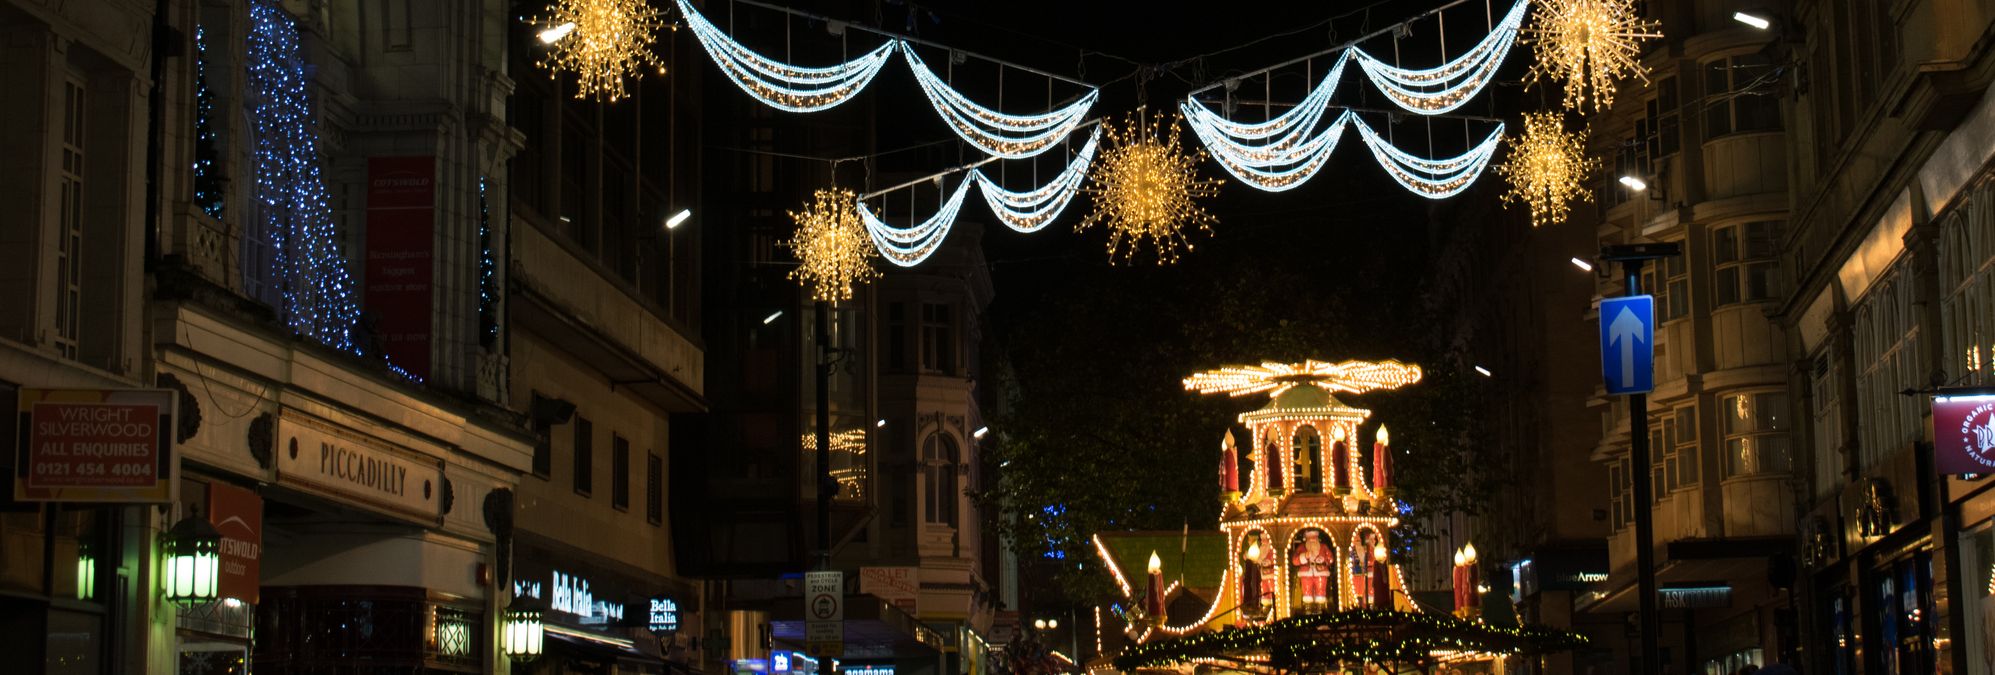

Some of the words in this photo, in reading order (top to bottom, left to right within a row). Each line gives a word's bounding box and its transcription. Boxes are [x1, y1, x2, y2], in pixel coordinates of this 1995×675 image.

[59, 407, 133, 422] WRIGHT
[1961, 403, 1993, 434] ORGANIC
[39, 422, 151, 437] SILVERWOOD
[41, 442, 68, 456] ALL
[72, 443, 149, 457] ENQUIRIES
[36, 463, 70, 475] 0121
[76, 463, 105, 475] 454
[111, 464, 151, 476] 4004
[321, 441, 406, 497] PICCADILLY
[552, 570, 572, 613] Bella
[572, 576, 592, 618] Italia
[1665, 591, 1686, 608] ASK
[650, 599, 677, 612] Bella
[650, 612, 677, 624] Italia
